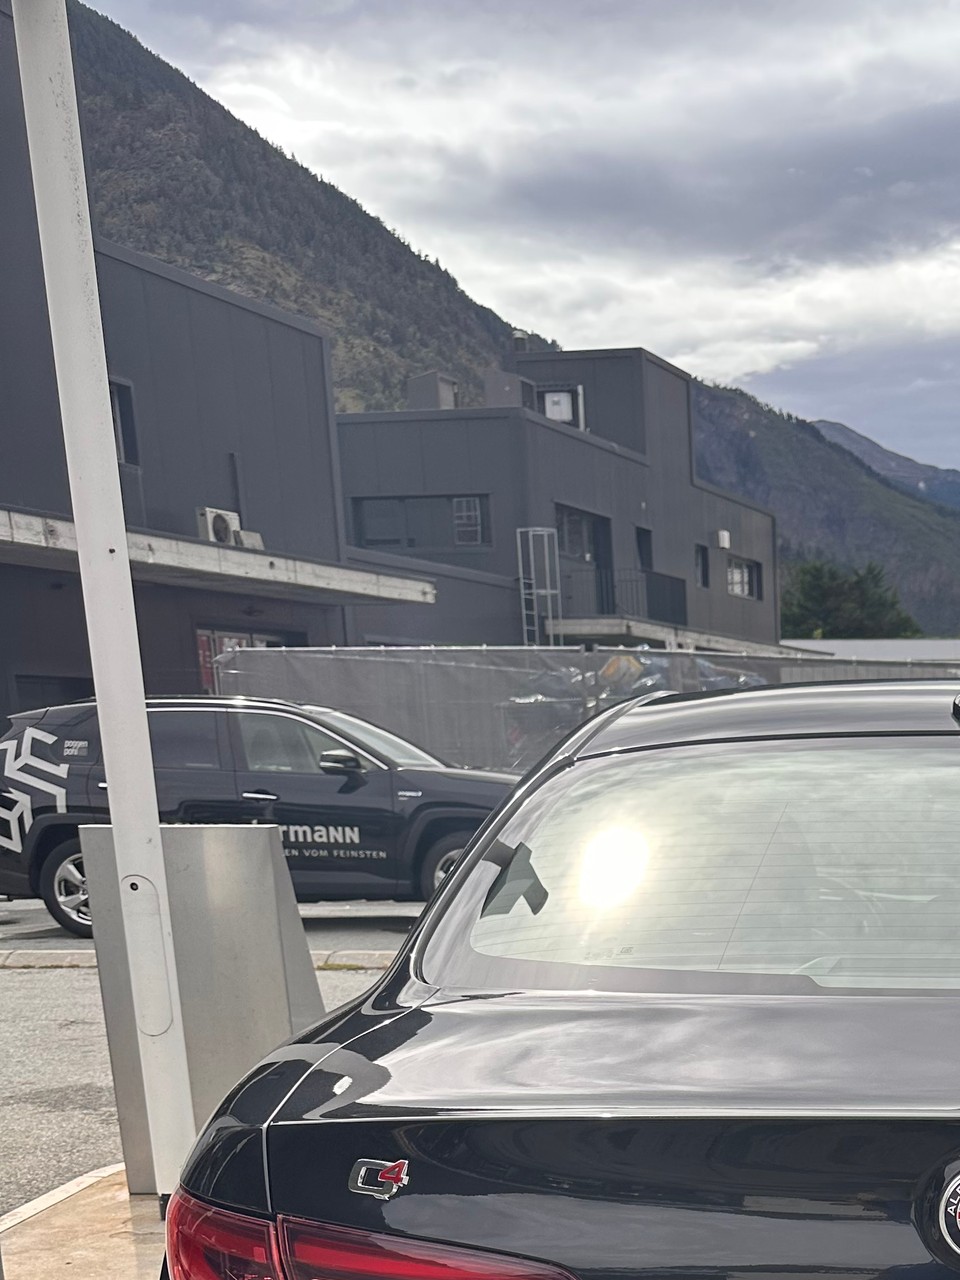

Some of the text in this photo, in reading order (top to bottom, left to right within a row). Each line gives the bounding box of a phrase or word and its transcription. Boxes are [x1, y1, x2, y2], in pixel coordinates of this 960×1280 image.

[303, 849, 329, 857] VOM
[333, 849, 387, 859] FEINSTEN
[348, 1158, 409, 1200] Q4
